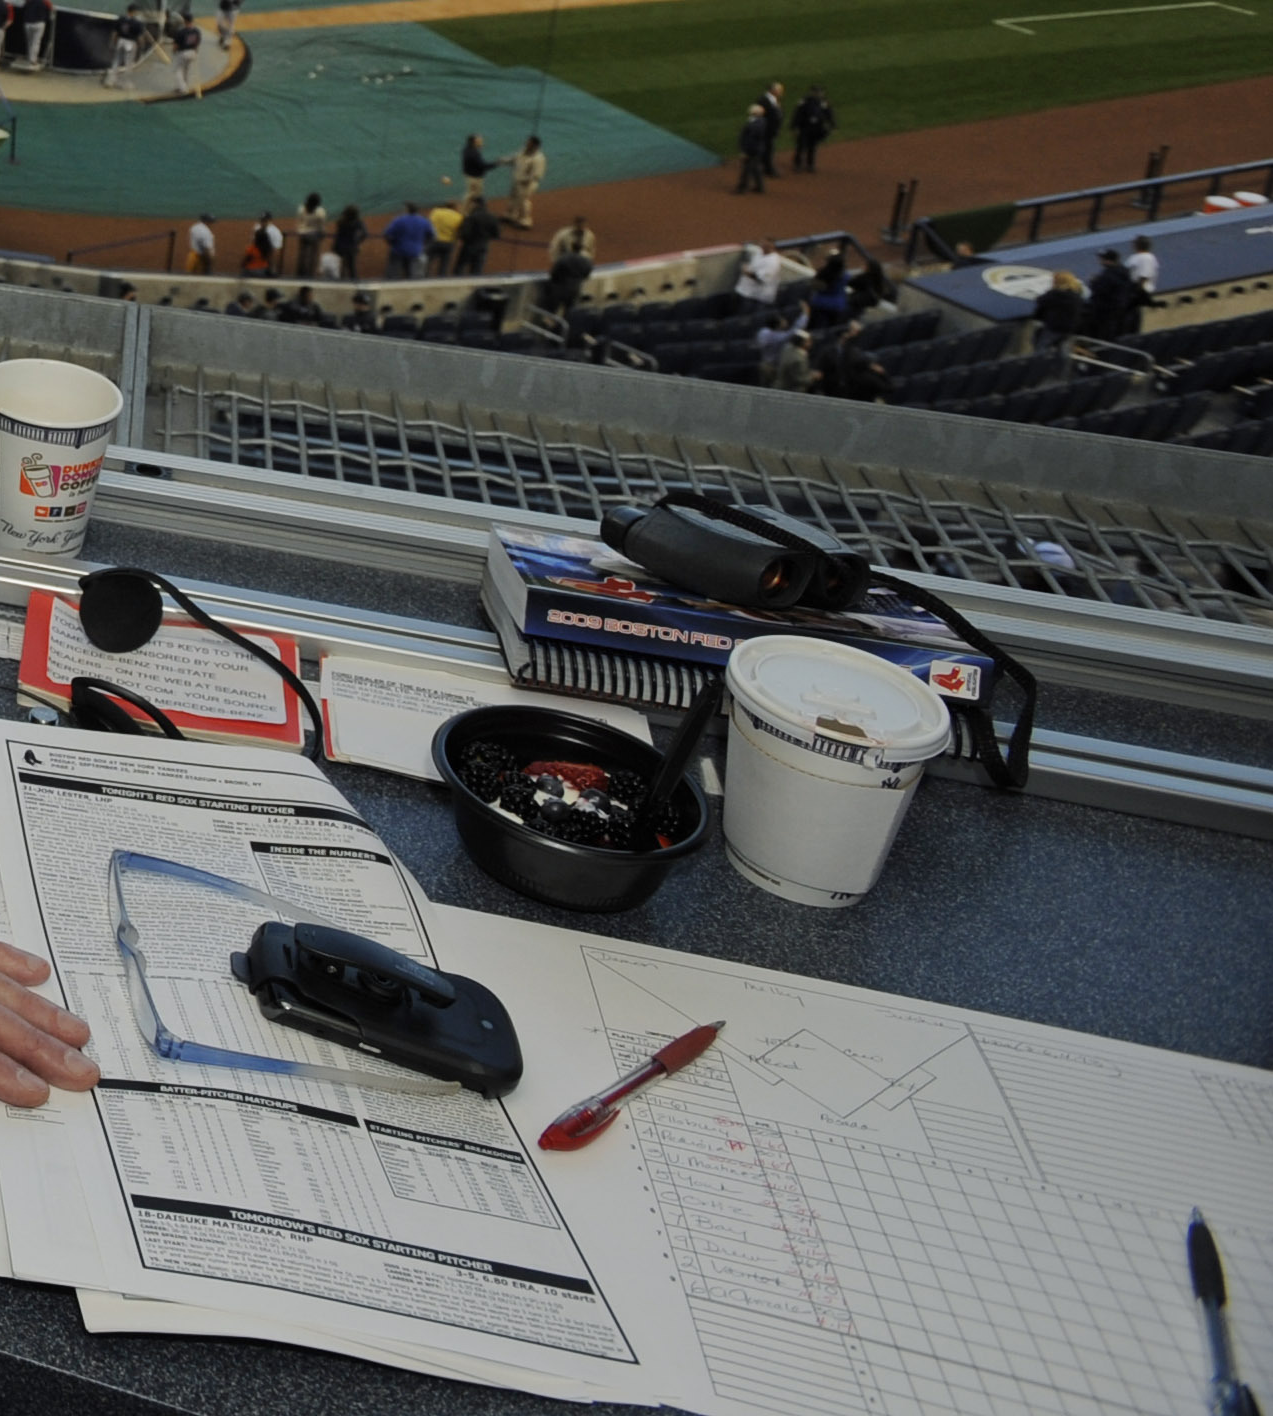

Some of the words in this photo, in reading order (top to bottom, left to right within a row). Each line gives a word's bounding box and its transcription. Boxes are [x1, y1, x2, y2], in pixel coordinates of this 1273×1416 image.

[0, 518, 28, 539] New
[26, 529, 62, 547] York
[546, 608, 602, 631] 2009
[603, 616, 688, 645] BOSTON
[688, 630, 733, 651] RED
[178, 641, 210, 656] KEYS
[214, 647, 234, 659] TO
[193, 657, 211, 668] BY
[214, 661, 249, 673] YOUR
[114, 666, 134, 677] ON
[137, 669, 160, 682] THE
[163, 675, 193, 688] WEB
[195, 680, 212, 691] AT
[214, 683, 267, 701] SEARCH
[154, 663, 217, 681] TRI-STATE
[116, 676, 142, 690] DOT
[184, 690, 220, 704] YOUR
[223, 696, 278, 713] SOURCE
[101, 786, 154, 800] TONIGHT'S
[155, 794, 176, 803] RED
[177, 796, 198, 806] SOX
[198, 798, 249, 813] STARTING
[250, 804, 296, 816] PITCHER
[269, 844, 305, 856] INSIDE
[307, 847, 327, 857] THE
[329, 848, 378, 862] NUMBERS
[159, 1084, 244, 1103] BATTER-PITCHER
[243, 1095, 299, 1113] MATCHUPS
[137, 1209, 210, 1227] 18-DAISUKE
[211, 1218, 287, 1241] MATSUZAKA,
[289, 1232, 314, 1244] RHP
[229, 1209, 316, 1235] TOMORROW'S
[317, 1226, 344, 1240] RED
[344, 1232, 371, 1247] SOX
[371, 1237, 437, 1262] STARTING
[437, 1251, 494, 1274] PITCHER
[455, 1269, 481, 1283] 3-5,
[512, 1280, 540, 1293] ERA,
[560, 1290, 596, 1305] starts
